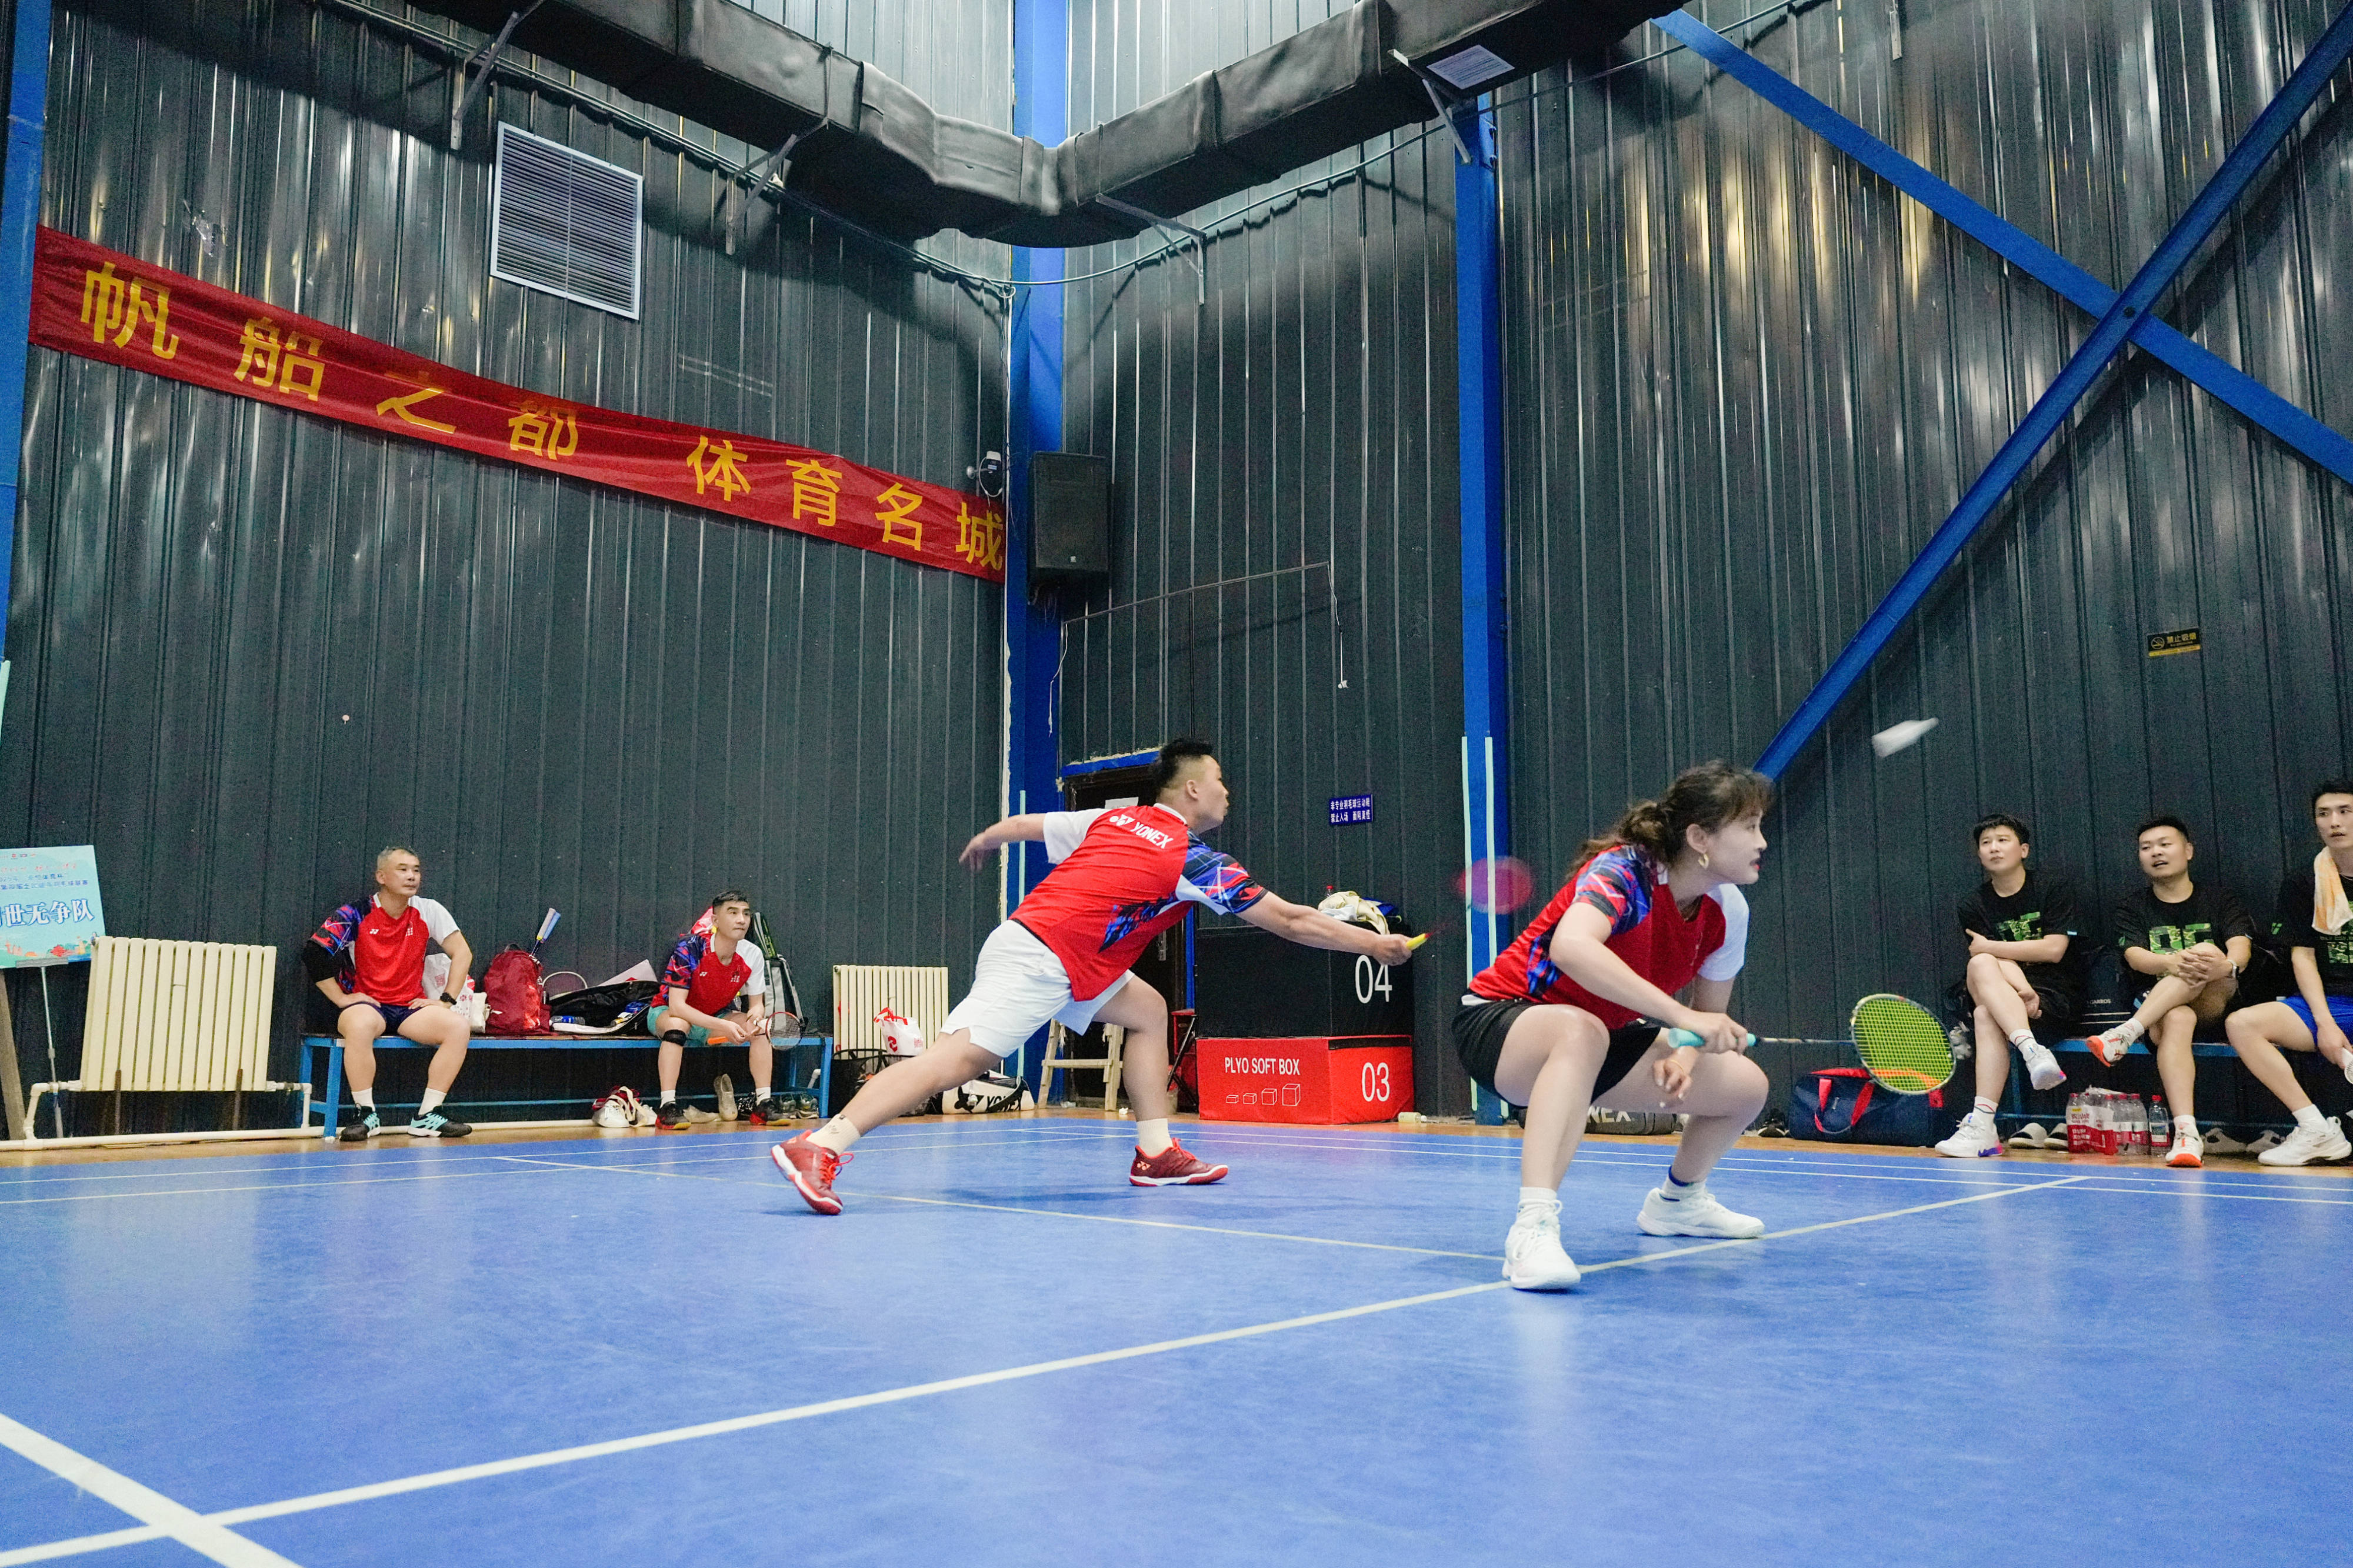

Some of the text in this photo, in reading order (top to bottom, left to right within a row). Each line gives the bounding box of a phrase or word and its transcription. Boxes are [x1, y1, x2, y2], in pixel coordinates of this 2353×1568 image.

[80, 261, 1003, 571] 帆船之都 体育名城
[1331, 812, 1348, 823] 禁止入场
[1129, 822, 1174, 849] YONEX
[0, 898, 95, 928] 世无争队
[1355, 955, 1392, 1004] 04
[1225, 1057, 1300, 1075] PLYO SOFT BOX
[1362, 1062, 1390, 1102] 03
